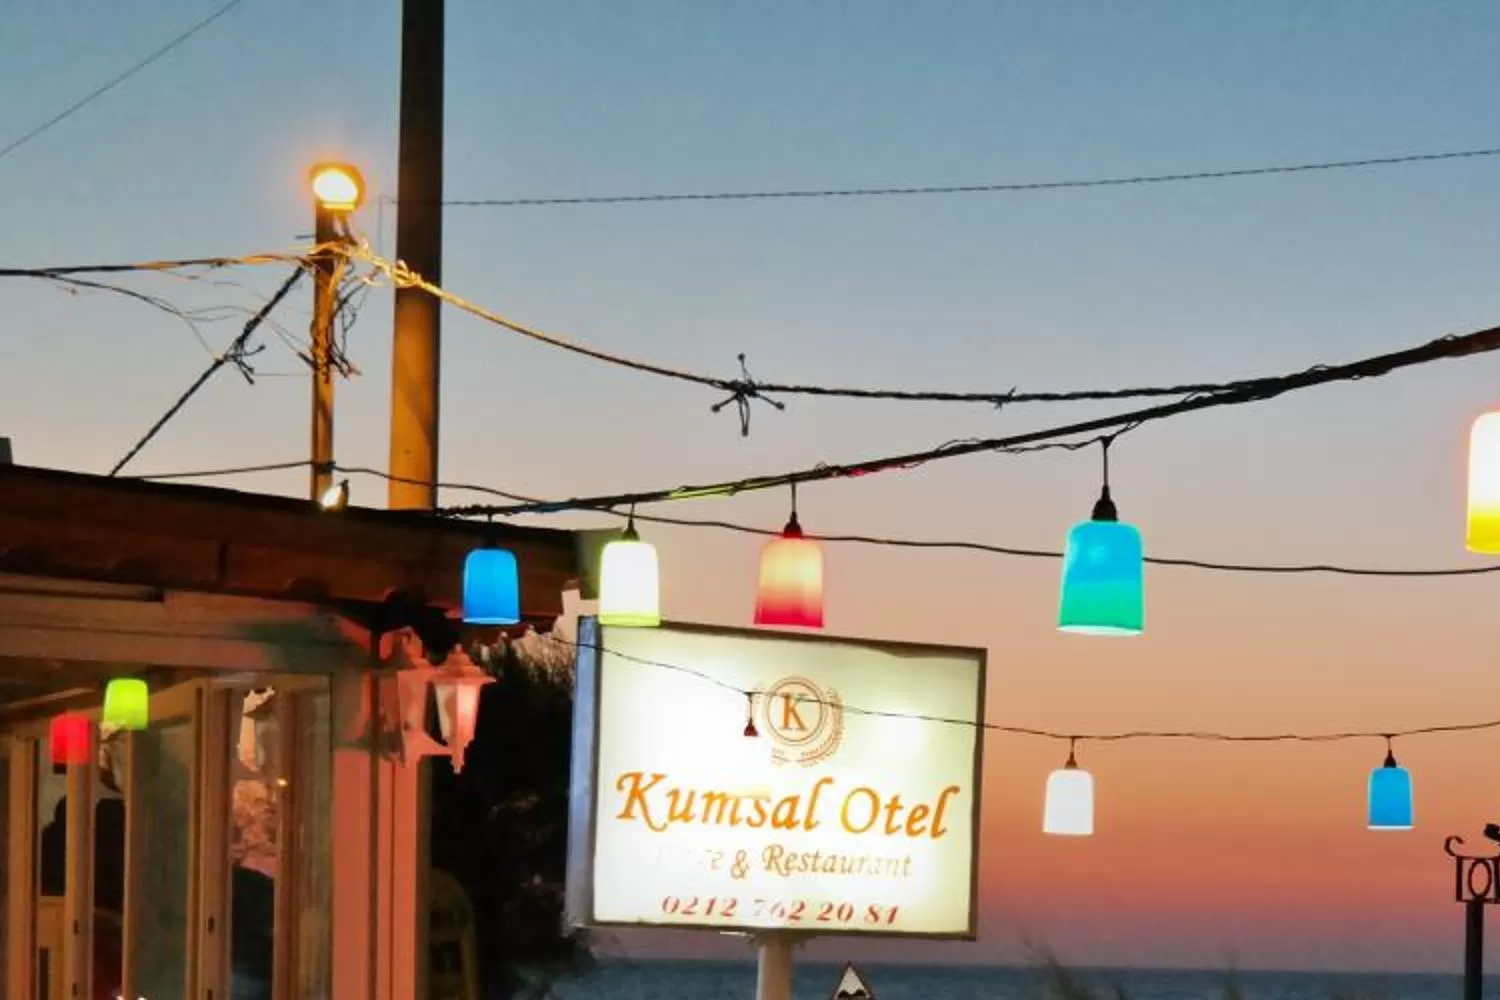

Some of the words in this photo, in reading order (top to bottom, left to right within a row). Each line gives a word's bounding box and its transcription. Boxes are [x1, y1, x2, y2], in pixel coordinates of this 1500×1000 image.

[780, 692, 806, 731] K
[615, 771, 833, 832] Kumsal
[839, 786, 961, 839] Otel
[761, 843, 913, 879] Restaurant
[661, 895, 738, 919] 0212
[815, 901, 854, 925] 20
[863, 903, 900, 926] 81
